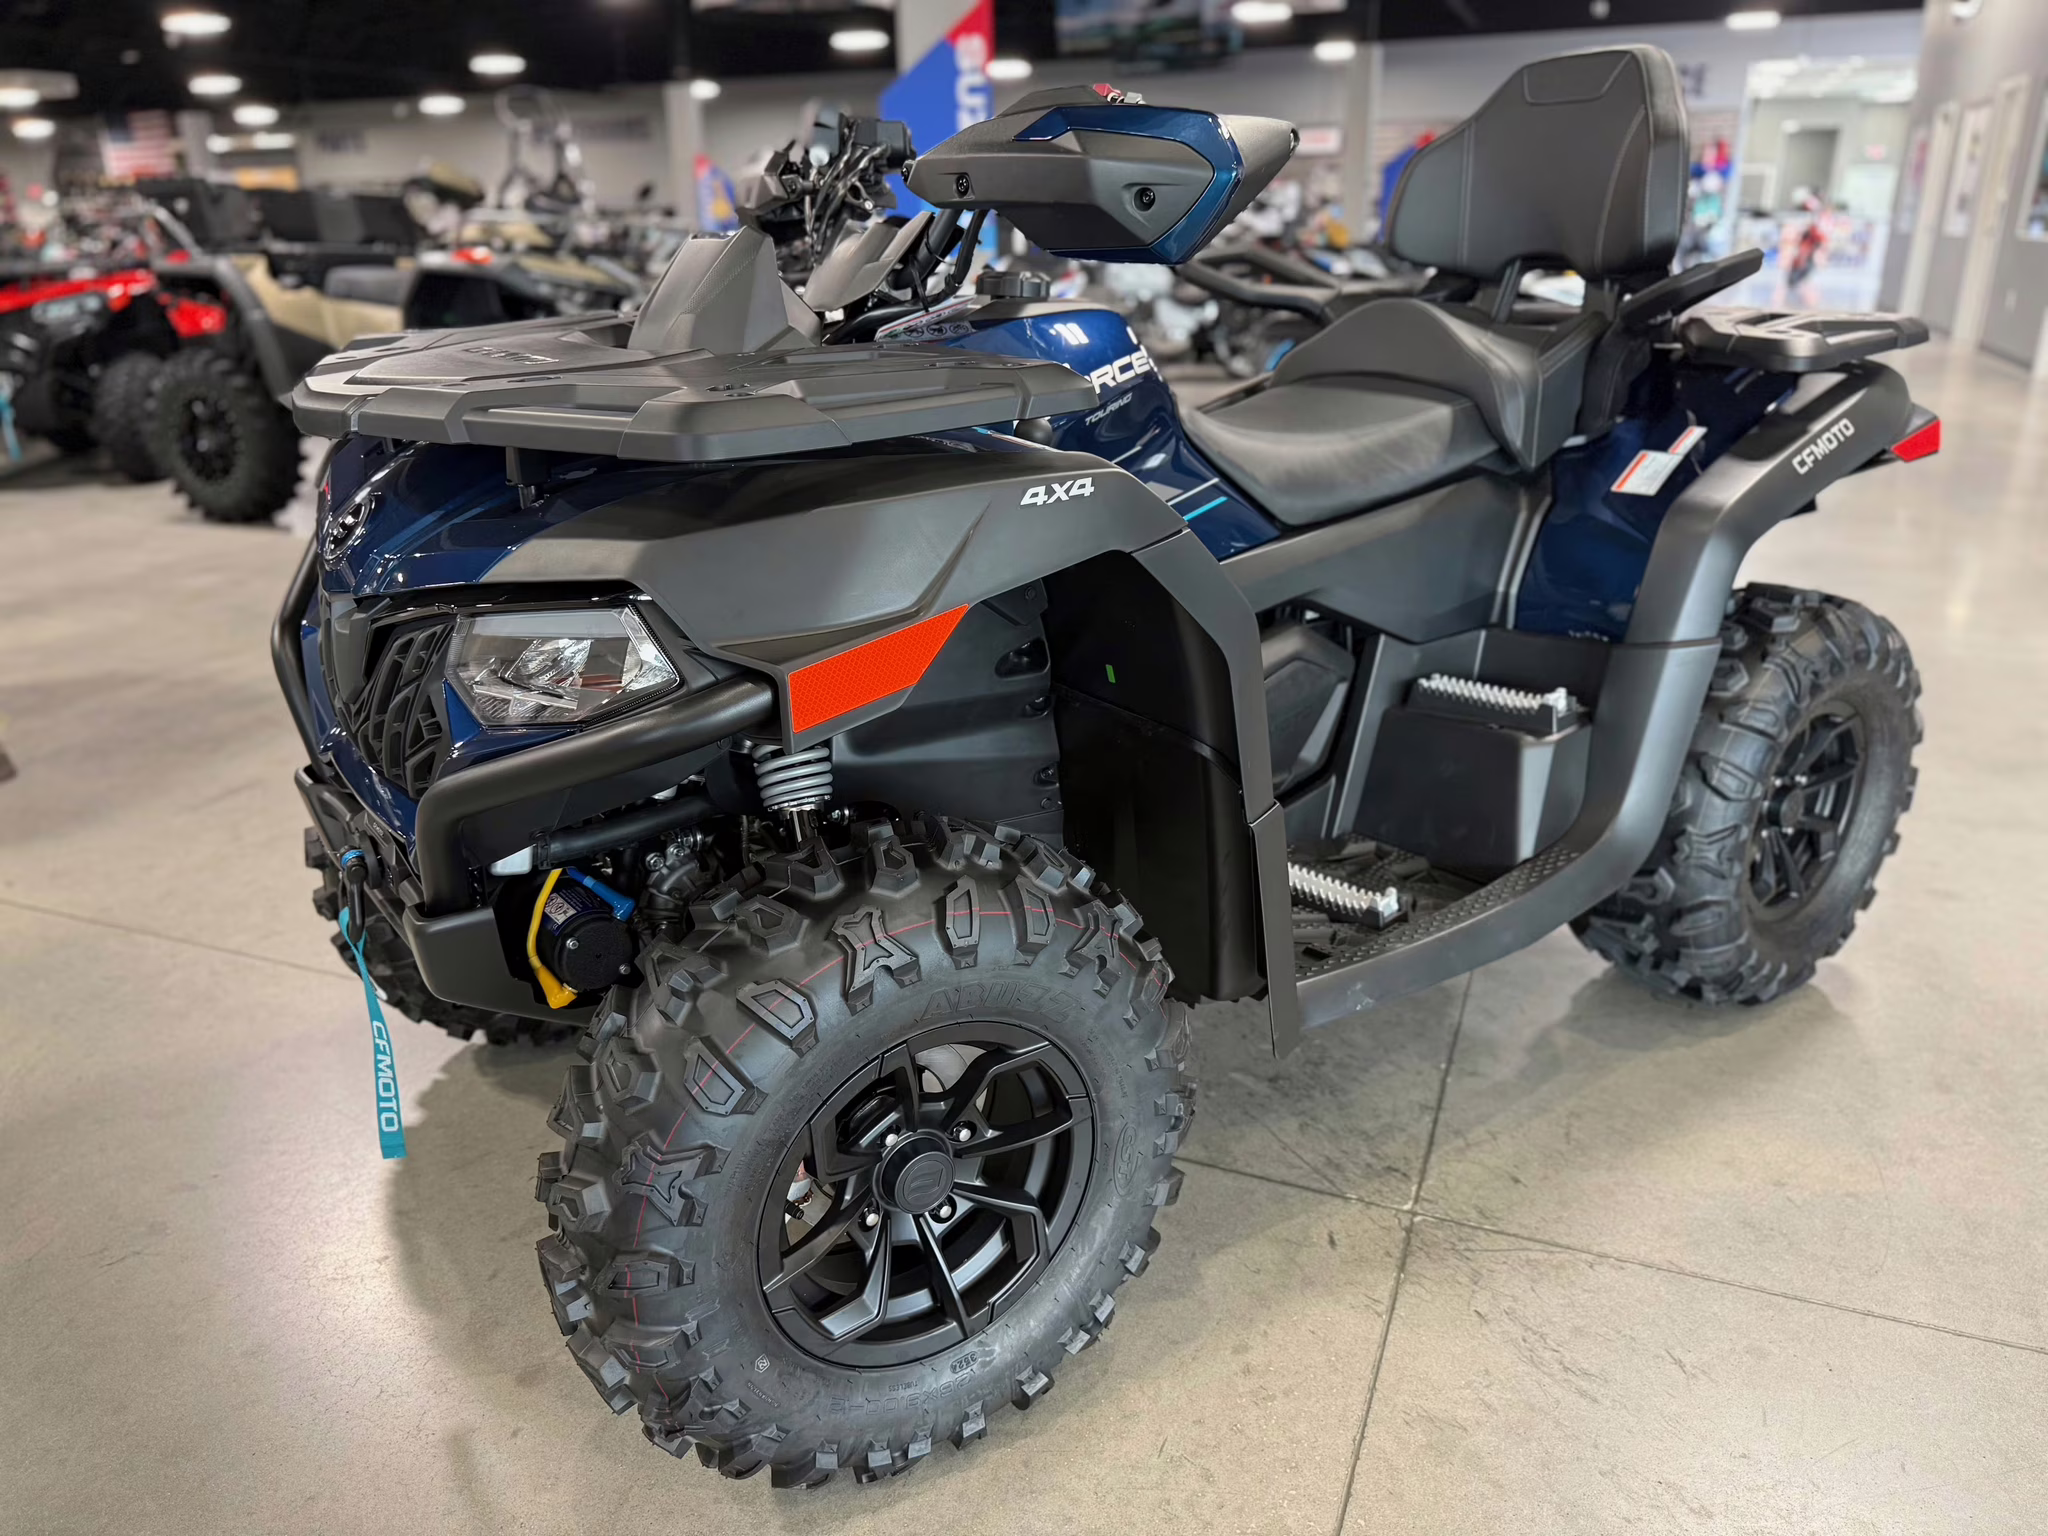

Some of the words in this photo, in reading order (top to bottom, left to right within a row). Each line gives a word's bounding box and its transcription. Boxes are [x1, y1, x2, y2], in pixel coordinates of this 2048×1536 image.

[1064, 350, 1152, 394] RCE
[1085, 392, 1133, 426] TOURING
[1791, 417, 1856, 475] CFMOTO
[1020, 477, 1095, 506] 4X4
[372, 1020, 400, 1132] CFMOTO
[888, 1380, 918, 1393] TUBELESS
